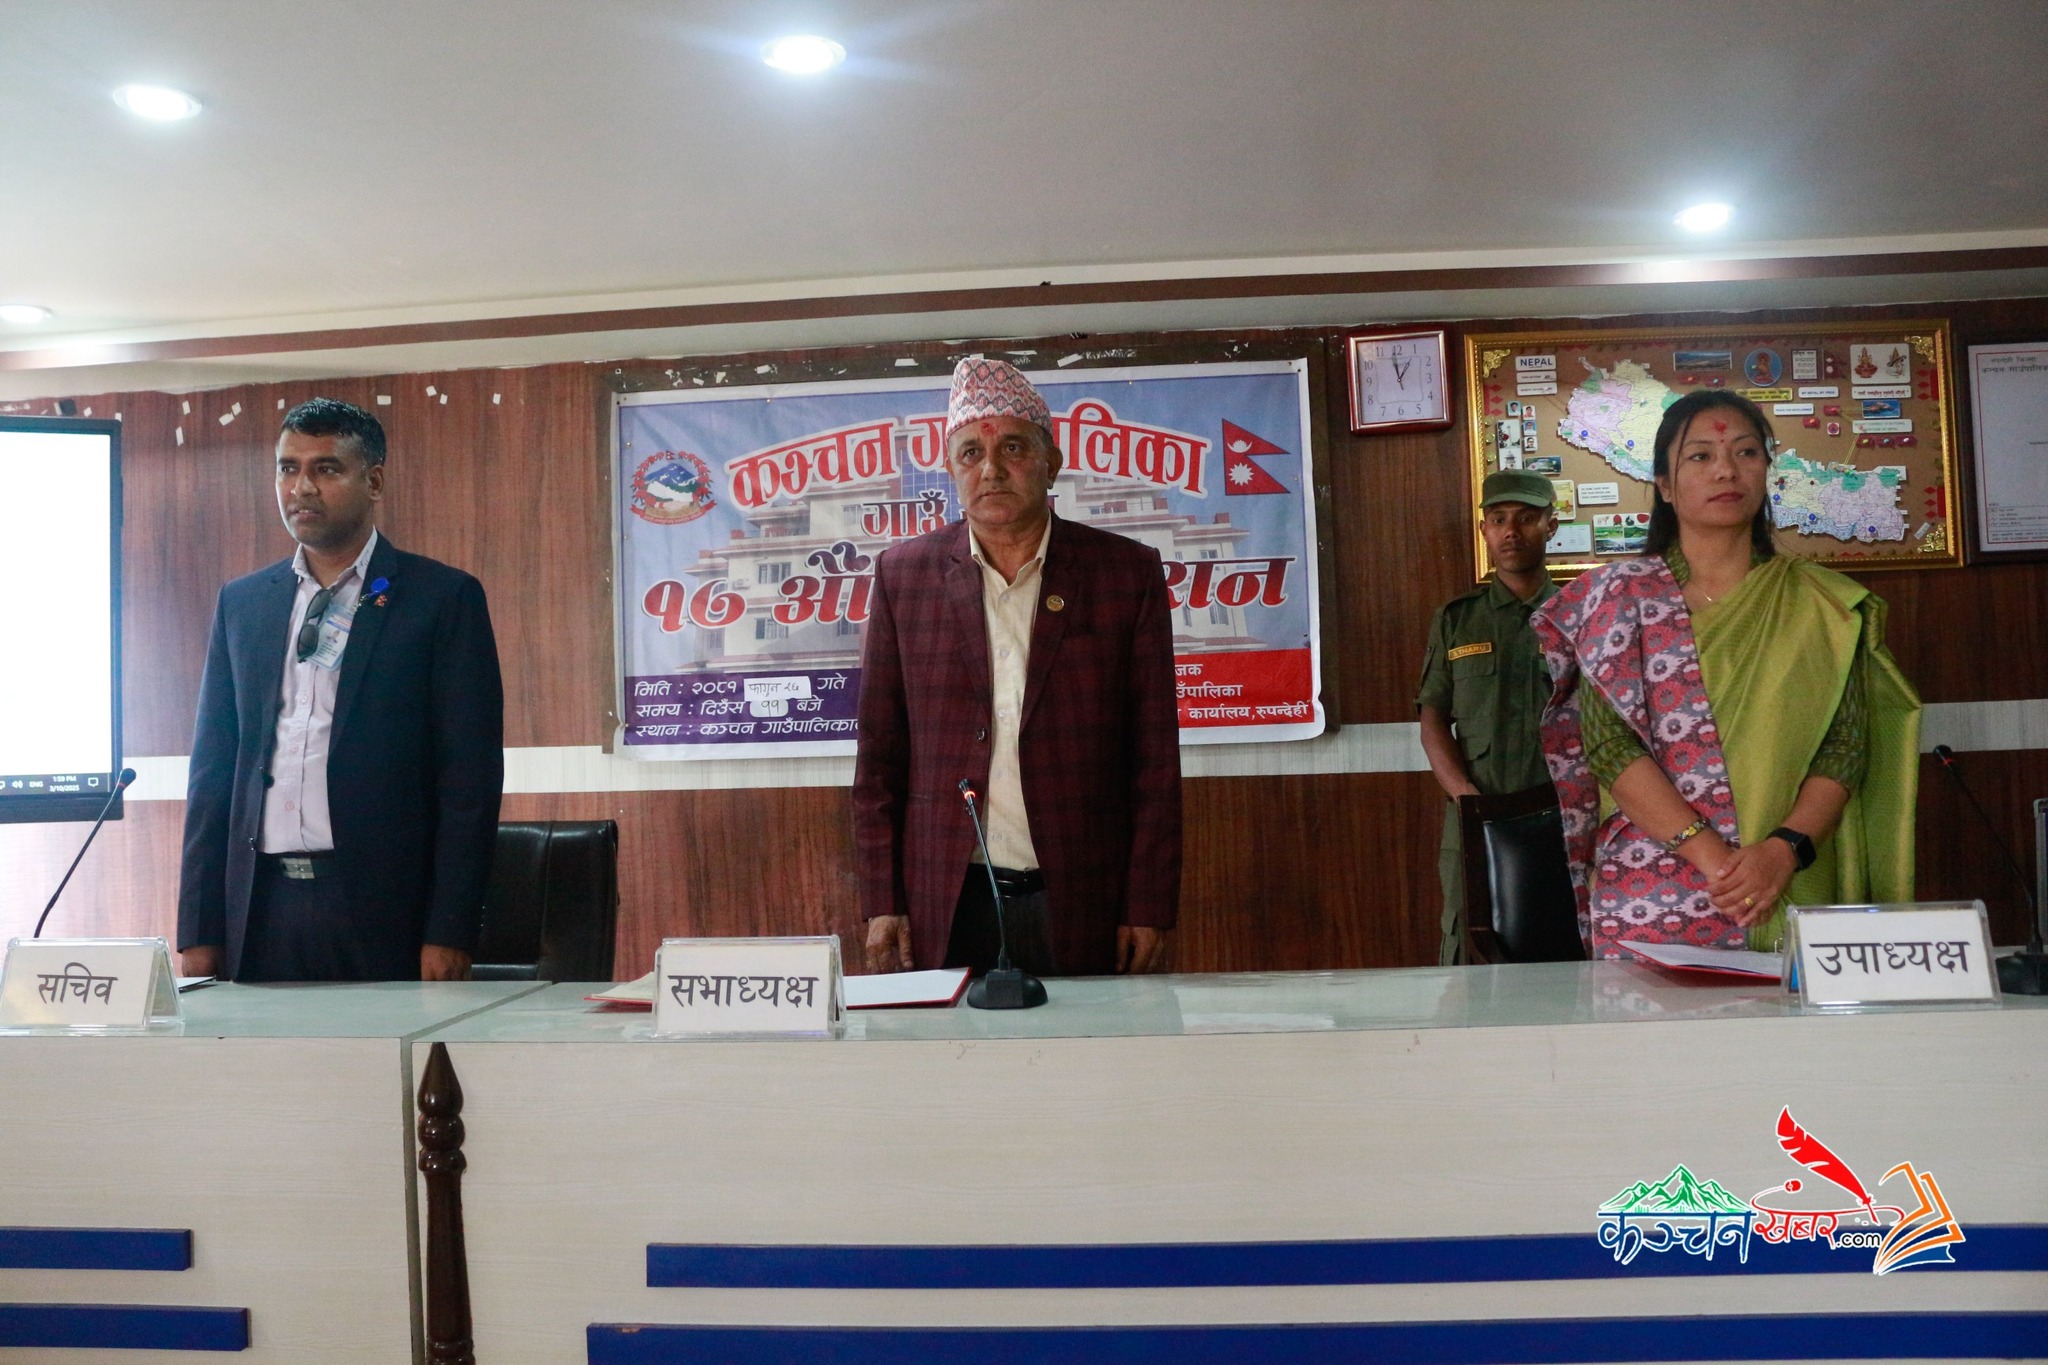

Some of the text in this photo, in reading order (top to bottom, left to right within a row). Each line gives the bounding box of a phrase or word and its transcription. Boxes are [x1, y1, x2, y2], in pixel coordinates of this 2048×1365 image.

[1376, 346, 1384, 357] 11
[1413, 344, 1417, 354] 1
[1364, 361, 1373, 370] 10
[1426, 356, 1431, 366] 2
[1520, 358, 1553, 367] NEPAL
[1367, 377, 1372, 386] 9
[1427, 373, 1432, 383] 3
[1368, 395, 1373, 405] 8
[1428, 391, 1433, 401] 4
[1381, 406, 1386, 416] 7
[1398, 406, 1404, 415] 6
[1416, 404, 1421, 414] 5
[643, 580, 746, 633] १७
[634, 680, 672, 697] मिति
[692, 682, 737, 695] २०८१
[817, 673, 847, 690] गते
[636, 703, 682, 717] समय
[700, 698, 745, 716] दिउँस
[761, 700, 779, 717] ११
[796, 695, 824, 712] बजे
[635, 724, 682, 738] स्थान
[700, 721, 757, 736] कञ्चन
[761, 717, 858, 734] गाउँपालिका
[1809, 941, 1971, 976] उपाध्यक्ष
[37, 962, 119, 1005] सचिव
[667, 975, 820, 1008] सभाध्यक्ष
